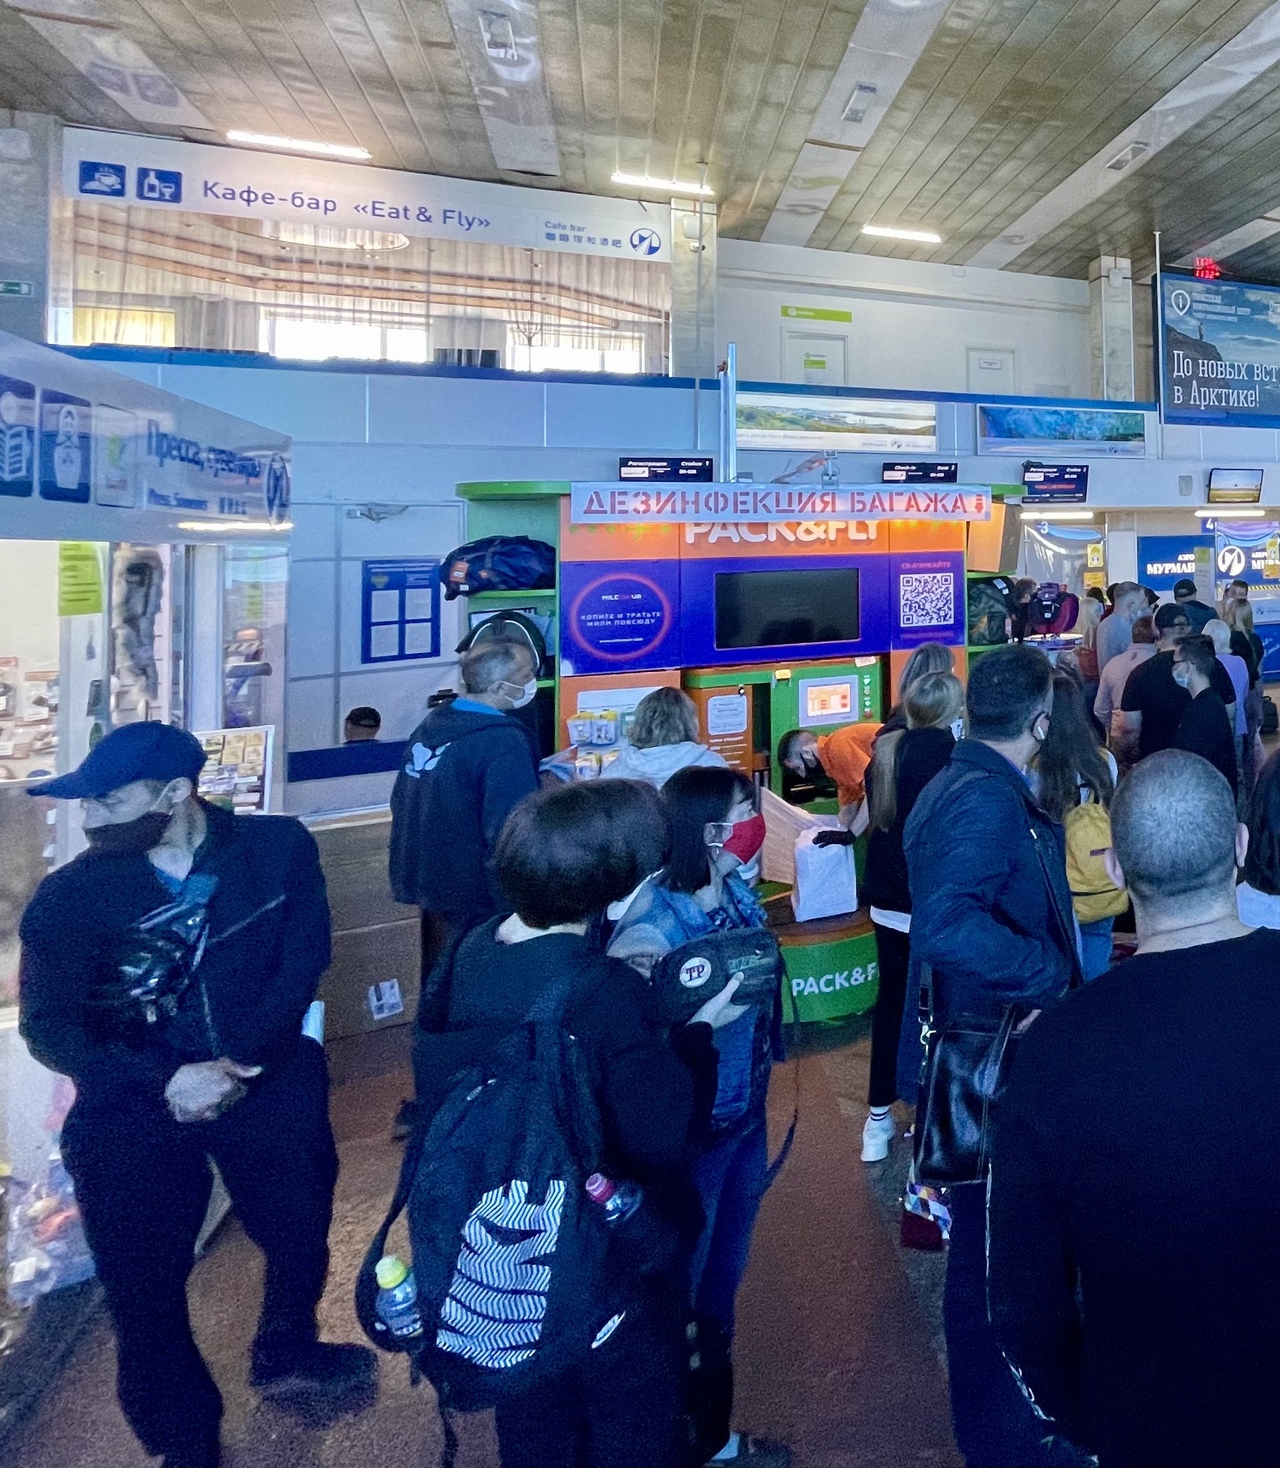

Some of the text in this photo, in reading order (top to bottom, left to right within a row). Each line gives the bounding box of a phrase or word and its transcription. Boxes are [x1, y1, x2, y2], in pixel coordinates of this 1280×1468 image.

[203, 179, 491, 231] Кафе-бар «Eat & Fly»
[544, 220, 586, 233] Cafe bar
[1173, 350, 1192, 379] До
[1198, 358, 1248, 380] новых
[1174, 380, 1259, 410] в Арктике!
[583, 490, 968, 516] ДЕЗИНФЕКЦИЯ БАГАЖА
[1040, 521, 1048, 534] 3
[1206, 518, 1214, 530] 4
[1147, 563, 1195, 574] МУРМАН
[791, 961, 877, 997] PACK&F
